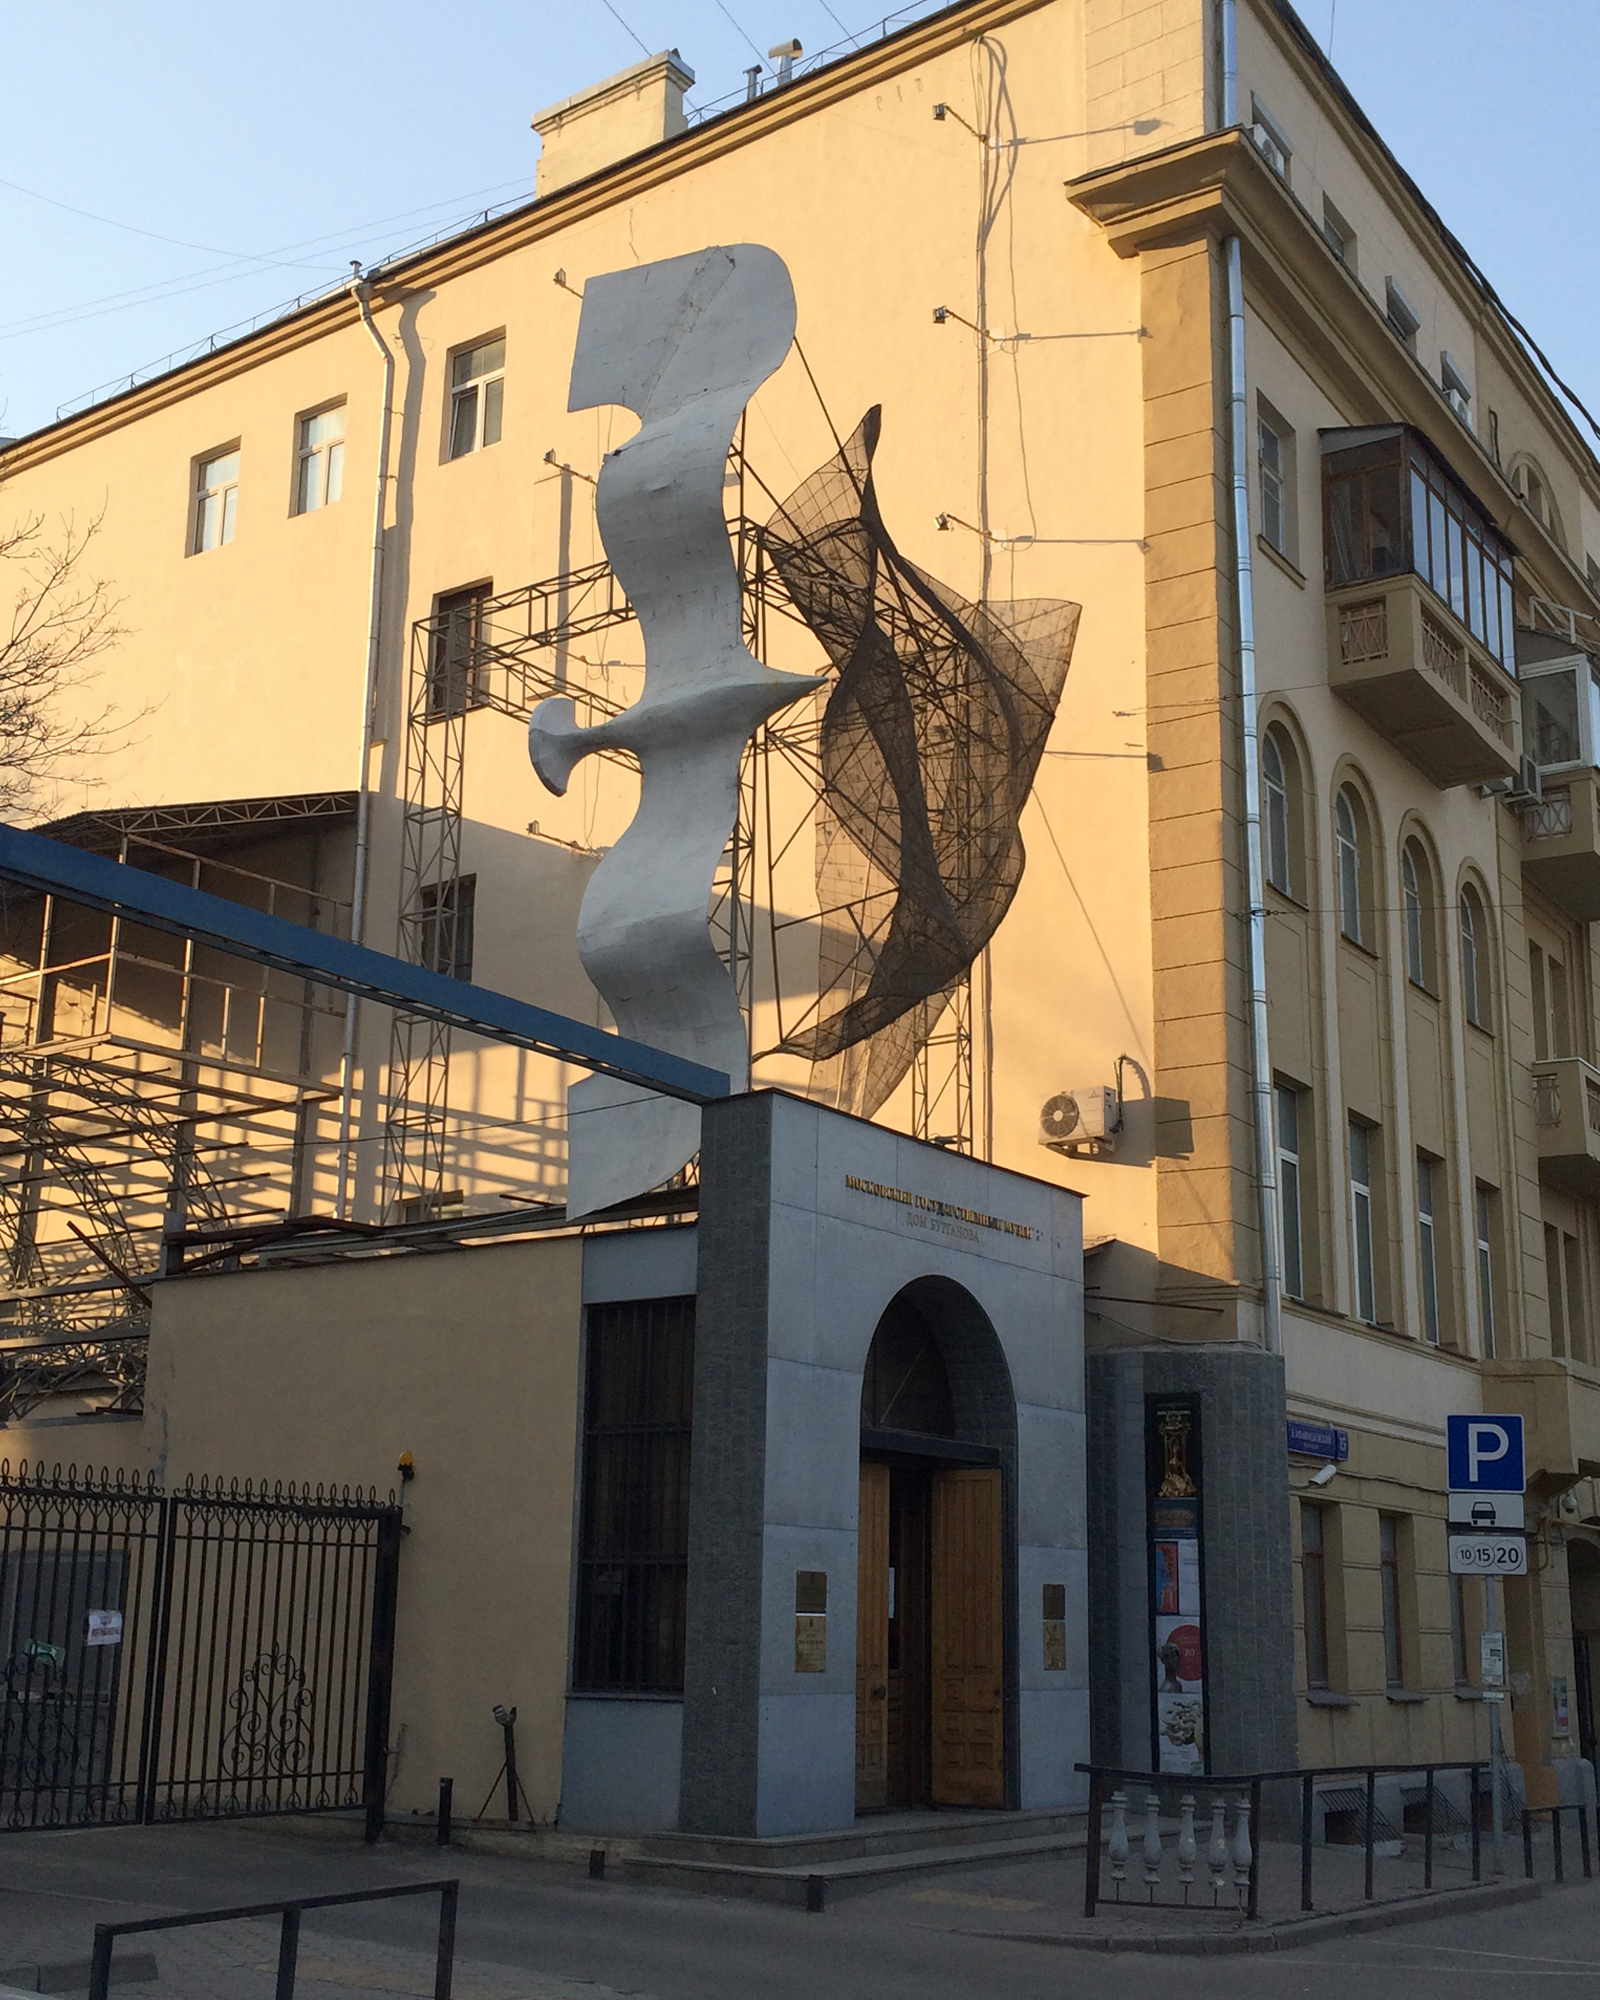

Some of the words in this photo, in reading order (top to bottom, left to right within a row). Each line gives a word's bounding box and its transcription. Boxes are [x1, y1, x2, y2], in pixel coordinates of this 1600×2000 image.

[846, 1174, 913, 1206] МОСКОВСКИЙ
[1004, 1222, 1033, 1240] МУЗЕЙ
[906, 1212, 928, 1229] ДОМ
[930, 1218, 980, 1243] БУРГАНОВА
[1468, 1423, 1510, 1482] P
[1460, 1550, 1472, 1560] 10
[1476, 1549, 1491, 1562] 15
[1497, 1547, 1519, 1564] 20
